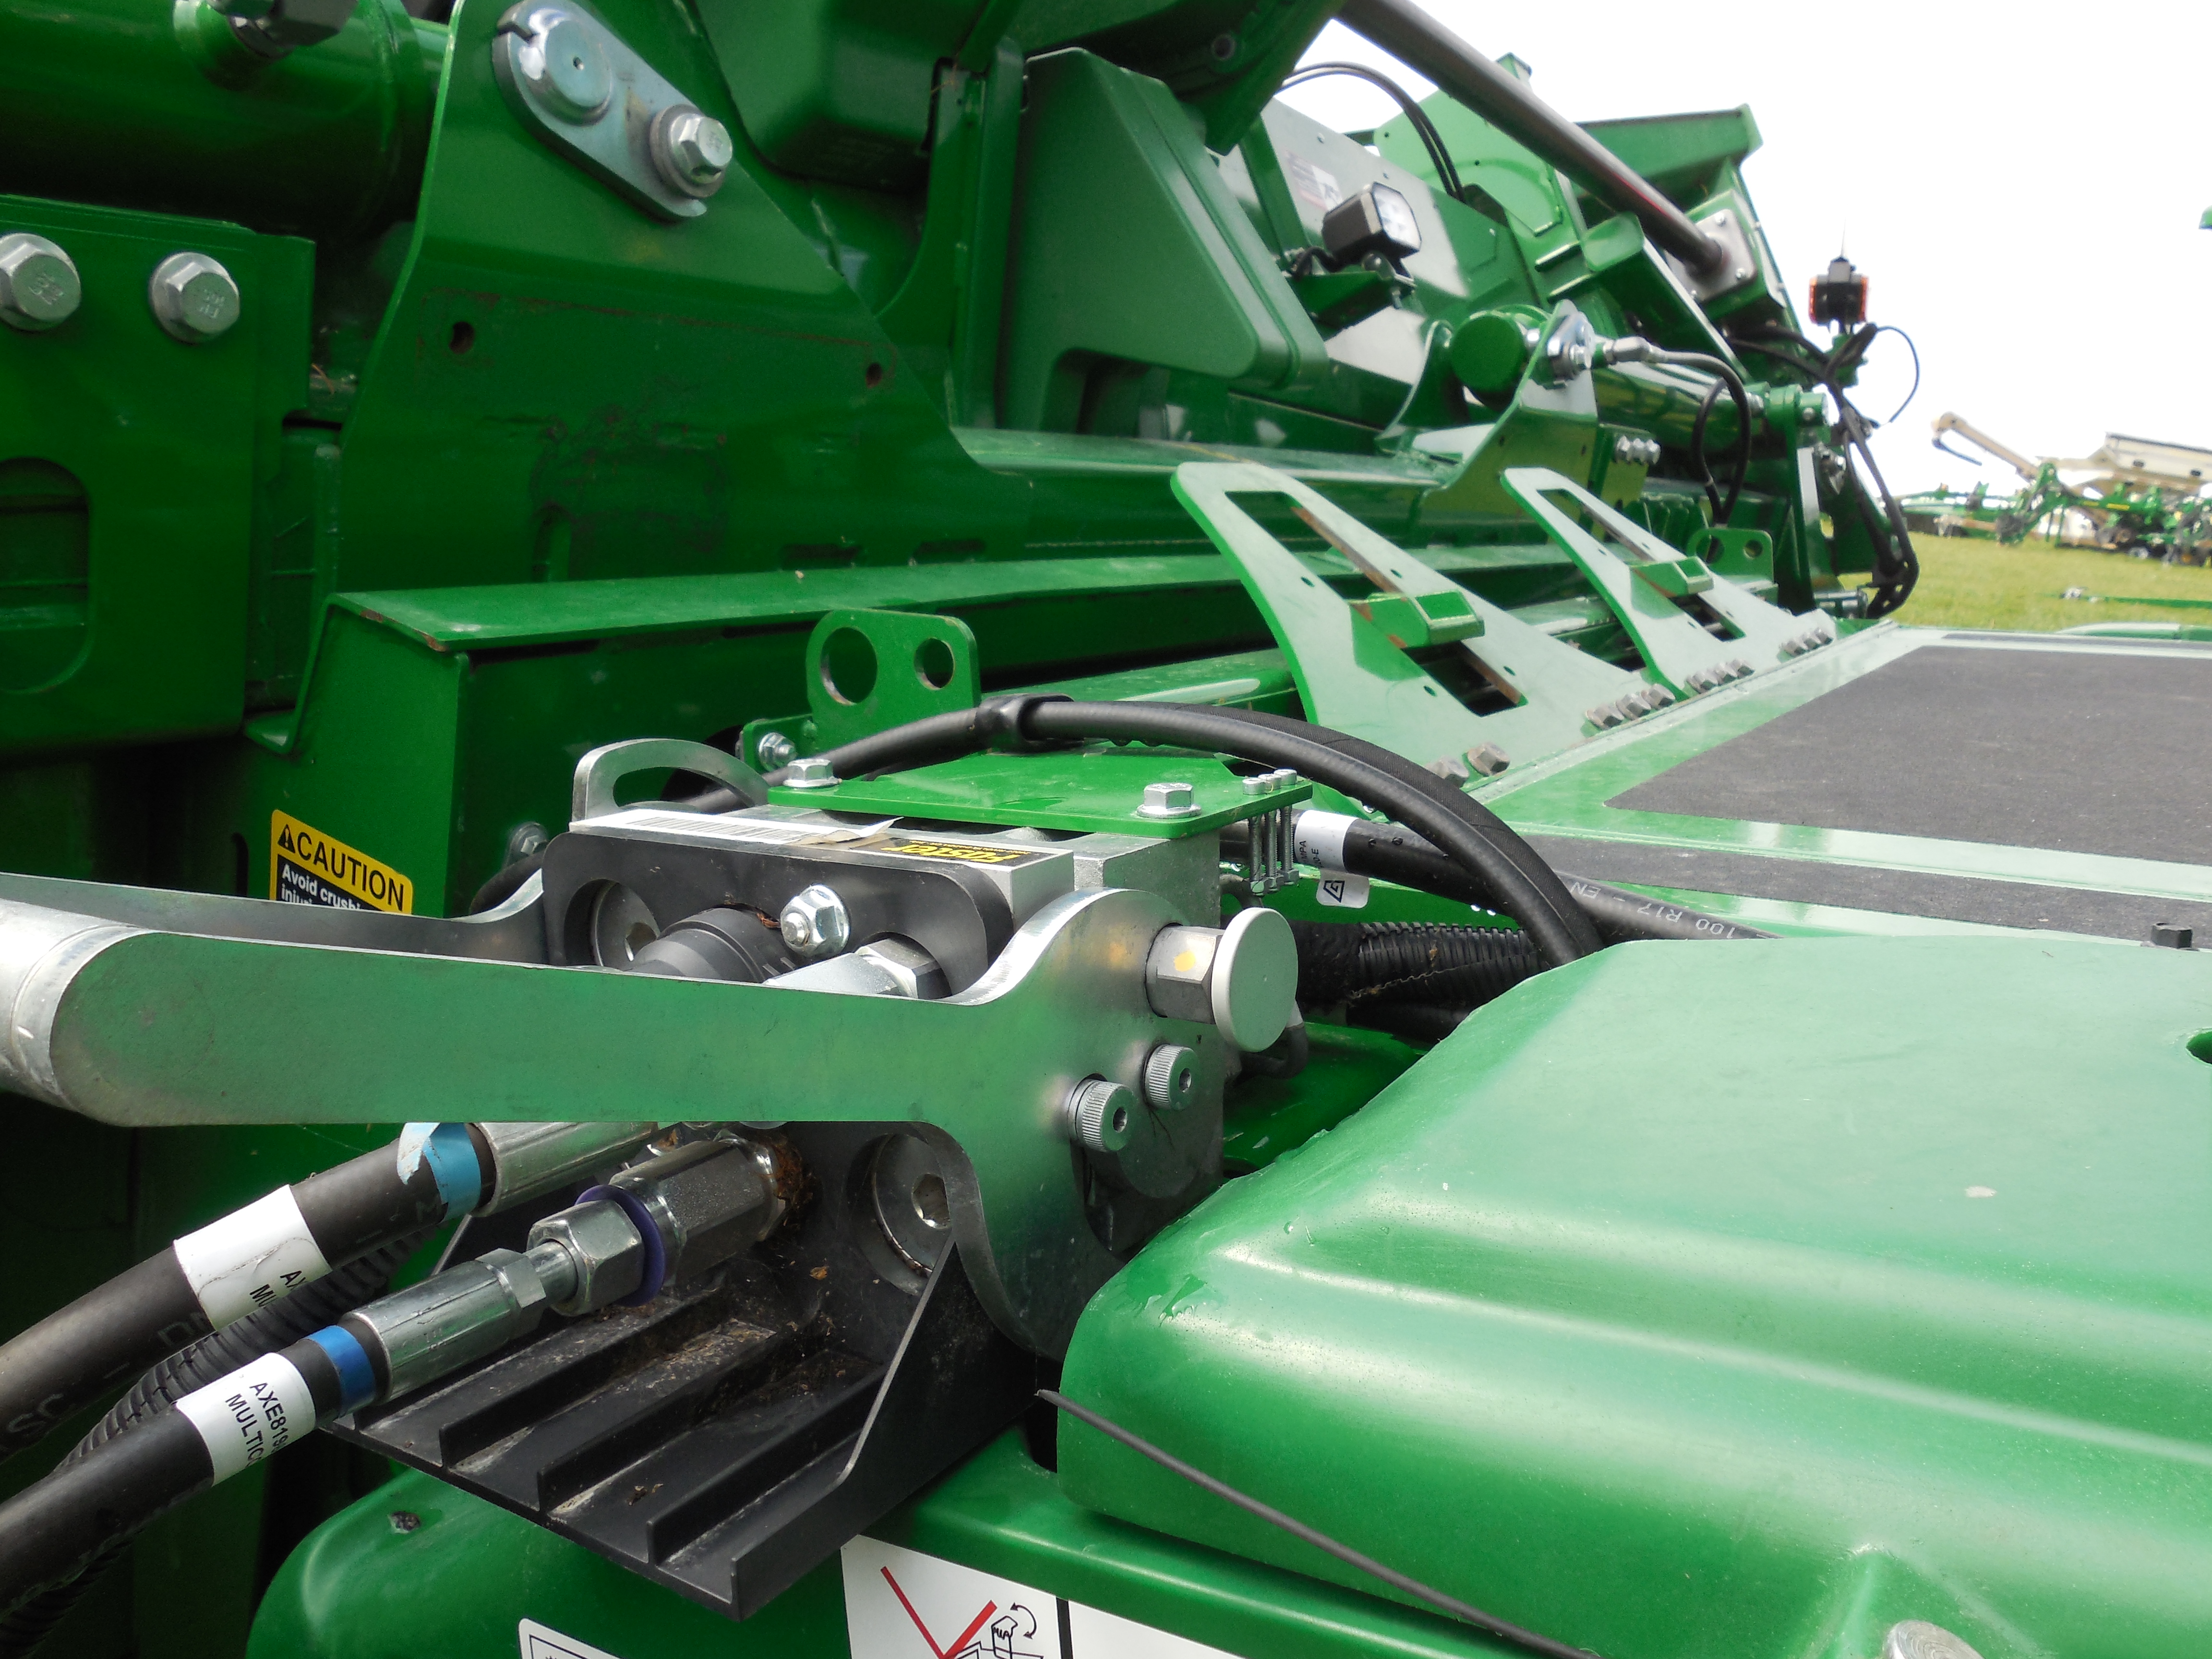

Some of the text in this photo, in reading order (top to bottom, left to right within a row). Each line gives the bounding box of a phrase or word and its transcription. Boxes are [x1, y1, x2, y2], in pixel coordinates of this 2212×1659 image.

[881, 844, 1021, 863] Faster
[282, 864, 361, 910] Avoid crush
[297, 832, 404, 911] CAUTION
[1570, 881, 1601, 899] EN
[1637, 903, 1683, 923] R17
[1695, 919, 1736, 939] 100
[225, 1394, 264, 1467] MULTIC
[249, 1382, 289, 1453] AXE819
